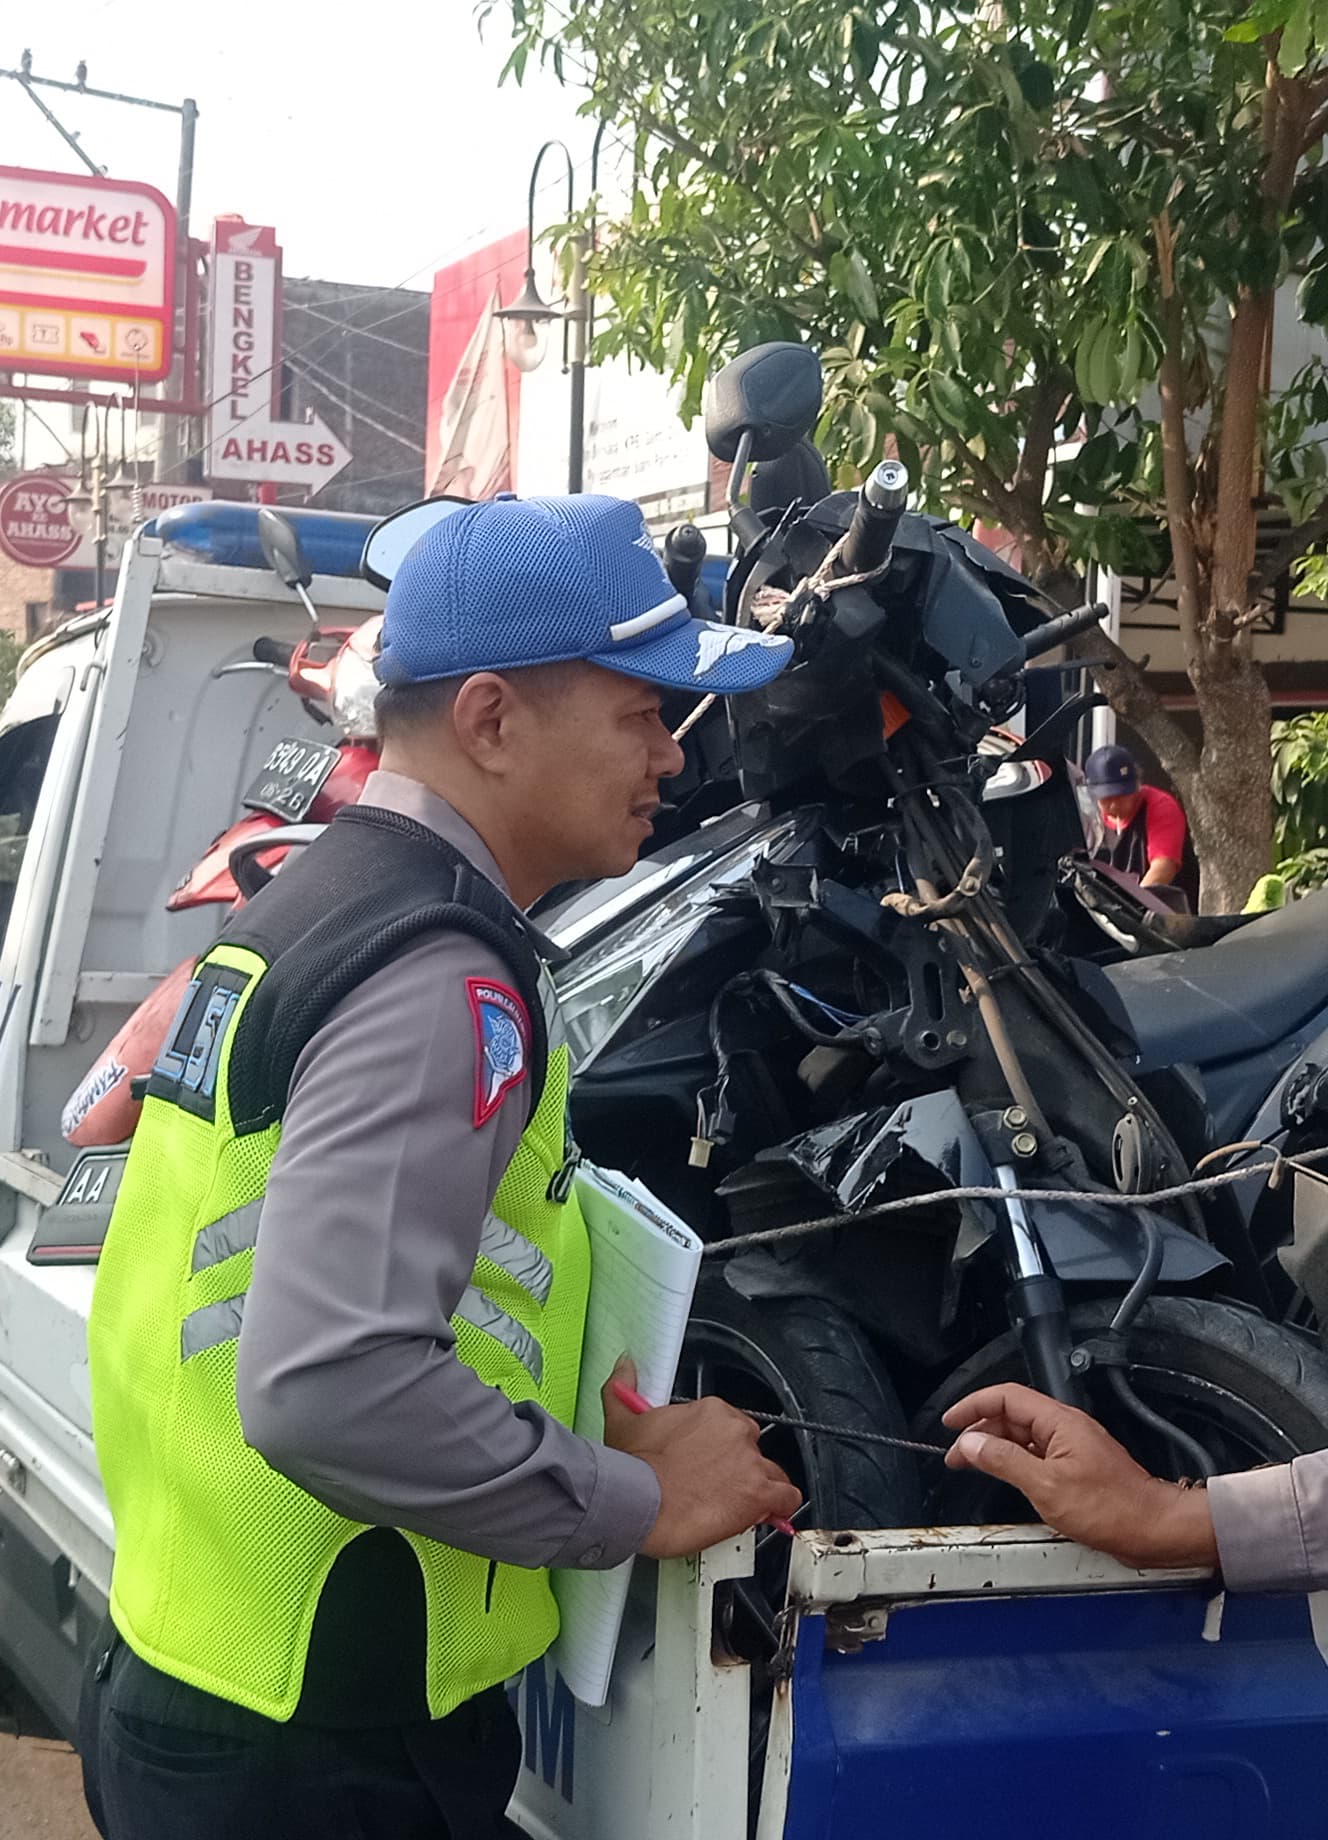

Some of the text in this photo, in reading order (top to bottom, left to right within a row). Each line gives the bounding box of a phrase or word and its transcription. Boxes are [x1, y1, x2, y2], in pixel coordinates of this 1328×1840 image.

[230, 261, 255, 421] BENGKEL
[222, 438, 336, 466] AHASS
[15, 493, 66, 513] AYO
[7, 521, 72, 540] AHASS
[68, 1166, 110, 1204] AA
